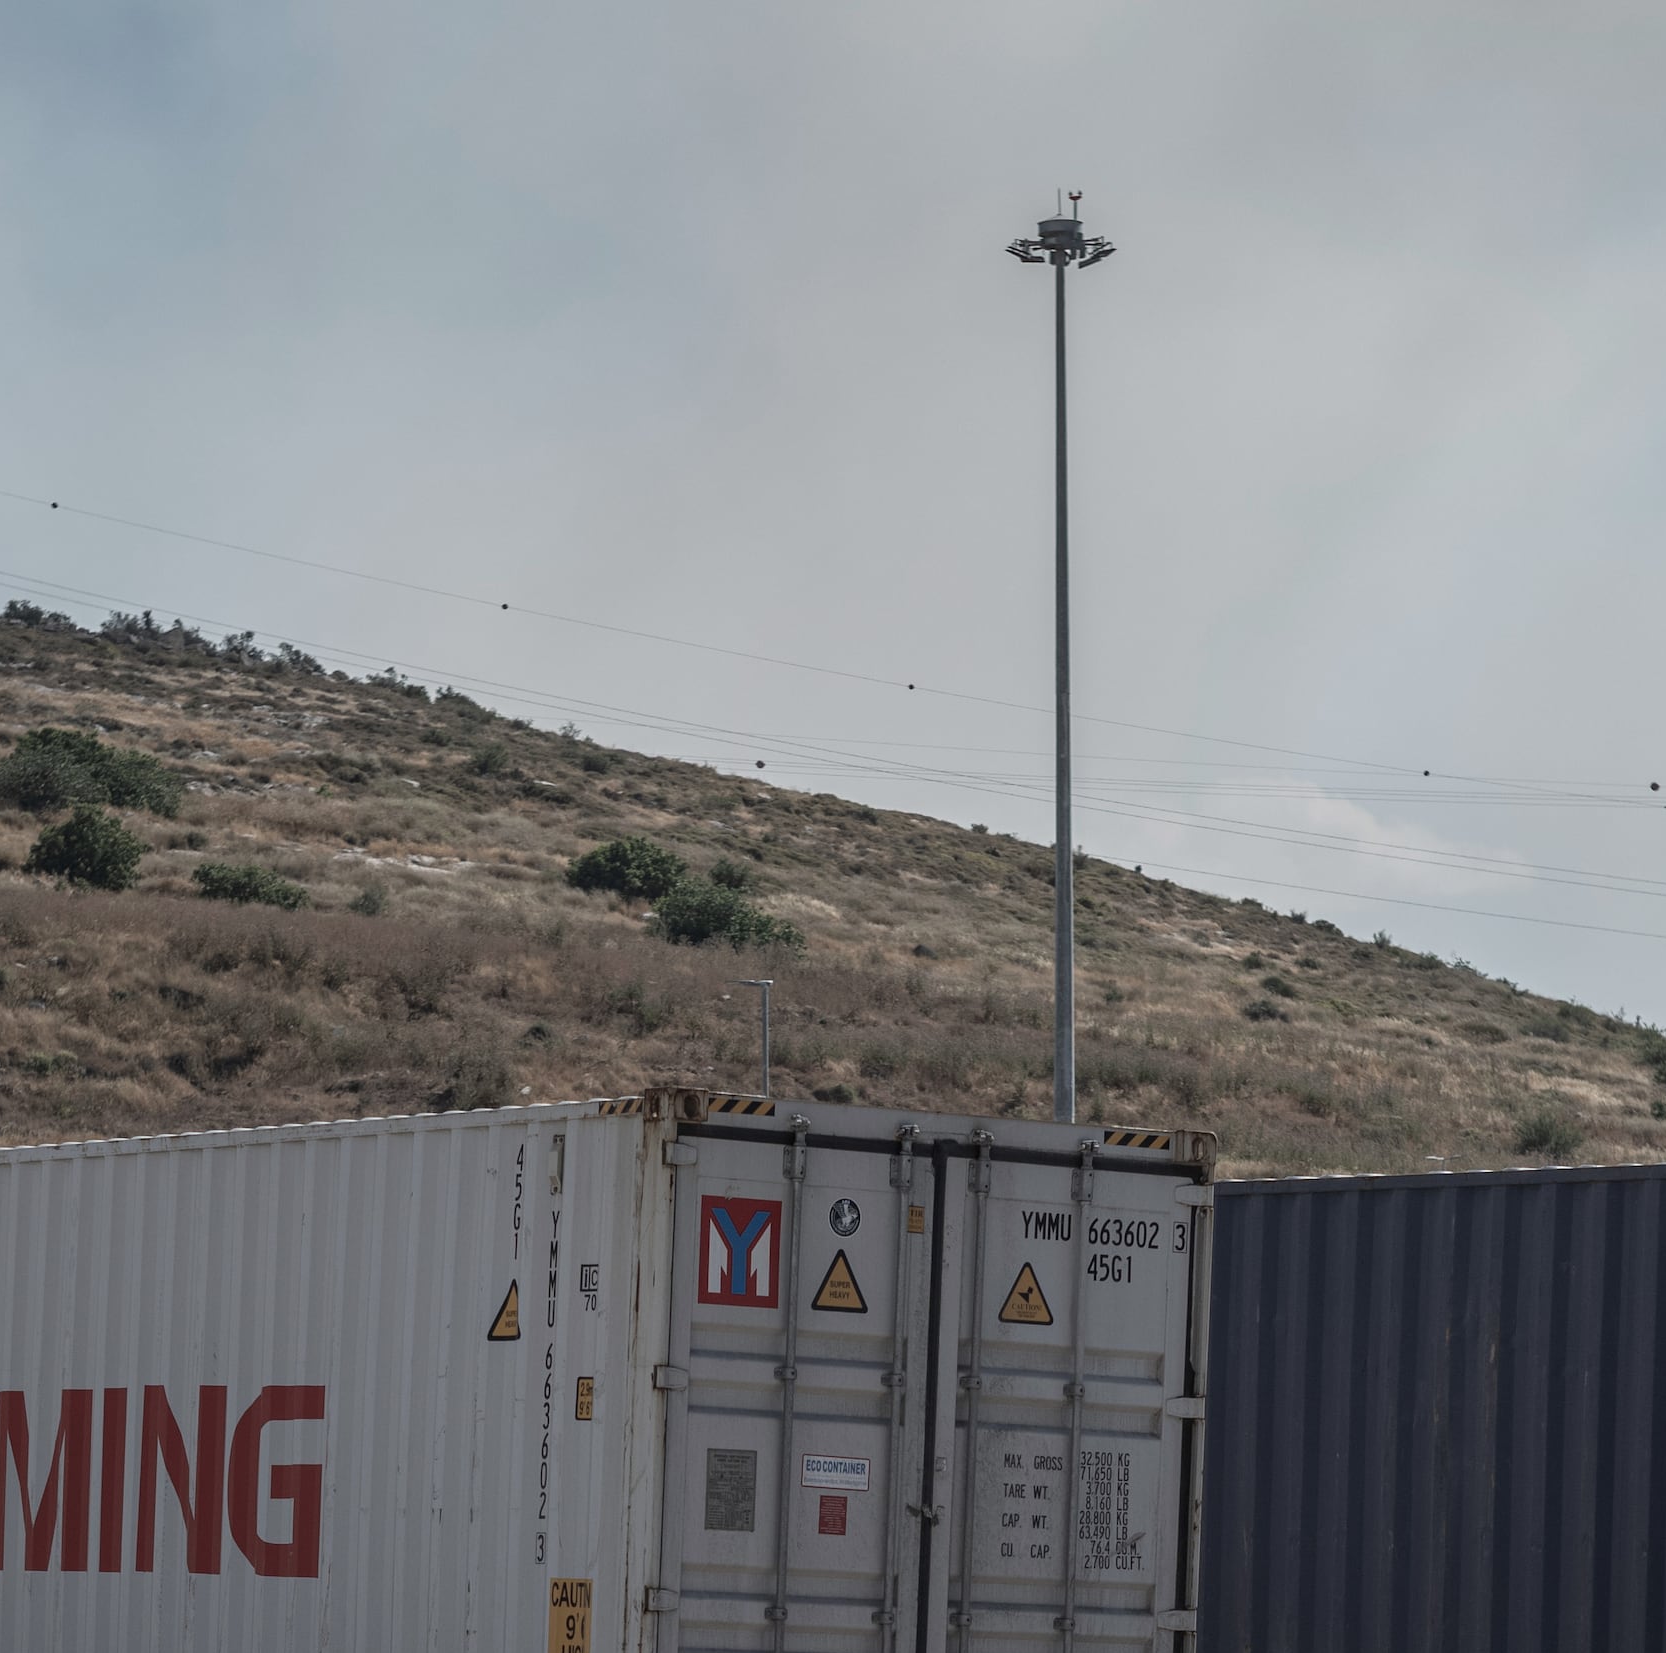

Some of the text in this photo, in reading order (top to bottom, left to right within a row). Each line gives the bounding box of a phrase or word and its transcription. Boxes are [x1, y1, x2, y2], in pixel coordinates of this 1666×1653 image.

[1022, 1211, 1186, 1251] YMMU 663602 3
[1088, 1254, 1132, 1283] 45G1
[584, 1295, 597, 1311] 70
[539, 1343, 553, 1519] 663602
[806, 1459, 866, 1475] ECO CONTAINER
[1034, 1456, 1063, 1471] GROSS
[1118, 1453, 1130, 1467] KG
[1118, 1468, 1129, 1481] LB
[1003, 1483, 1025, 1499] TARE
[1117, 1483, 1129, 1496] KG
[1117, 1497, 1129, 1510] LB
[1002, 1513, 1021, 1528] CAP.
[1116, 1512, 1128, 1526] KG
[1116, 1526, 1128, 1540] LB
